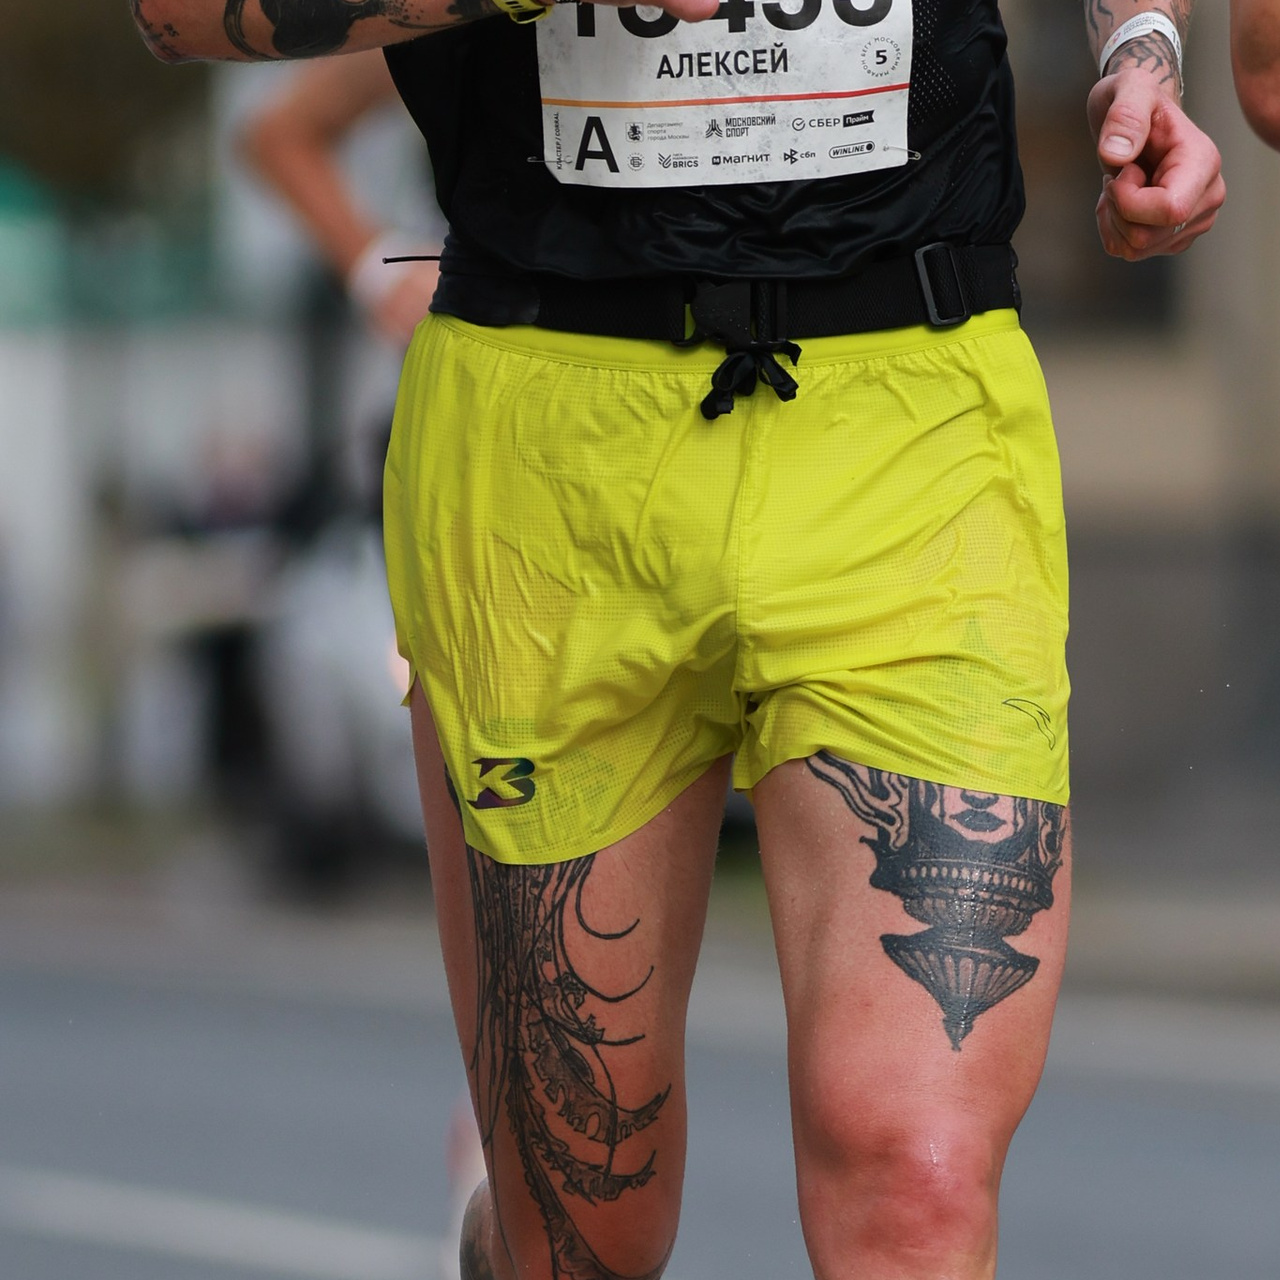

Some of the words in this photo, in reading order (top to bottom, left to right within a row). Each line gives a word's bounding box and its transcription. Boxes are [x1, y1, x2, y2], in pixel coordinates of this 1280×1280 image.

[656, 42, 789, 80] АЛЕКСЕЙ
[875, 49, 888, 65] 5
[725, 113, 776, 128] МОСКОВСКИЙ
[808, 118, 841, 128] СБЕР
[845, 115, 869, 125] Прайм
[725, 127, 751, 138] СПОРТ
[799, 150, 816, 159] сбп
[832, 145, 865, 157] WINLINE
[672, 160, 699, 169] BRICS
